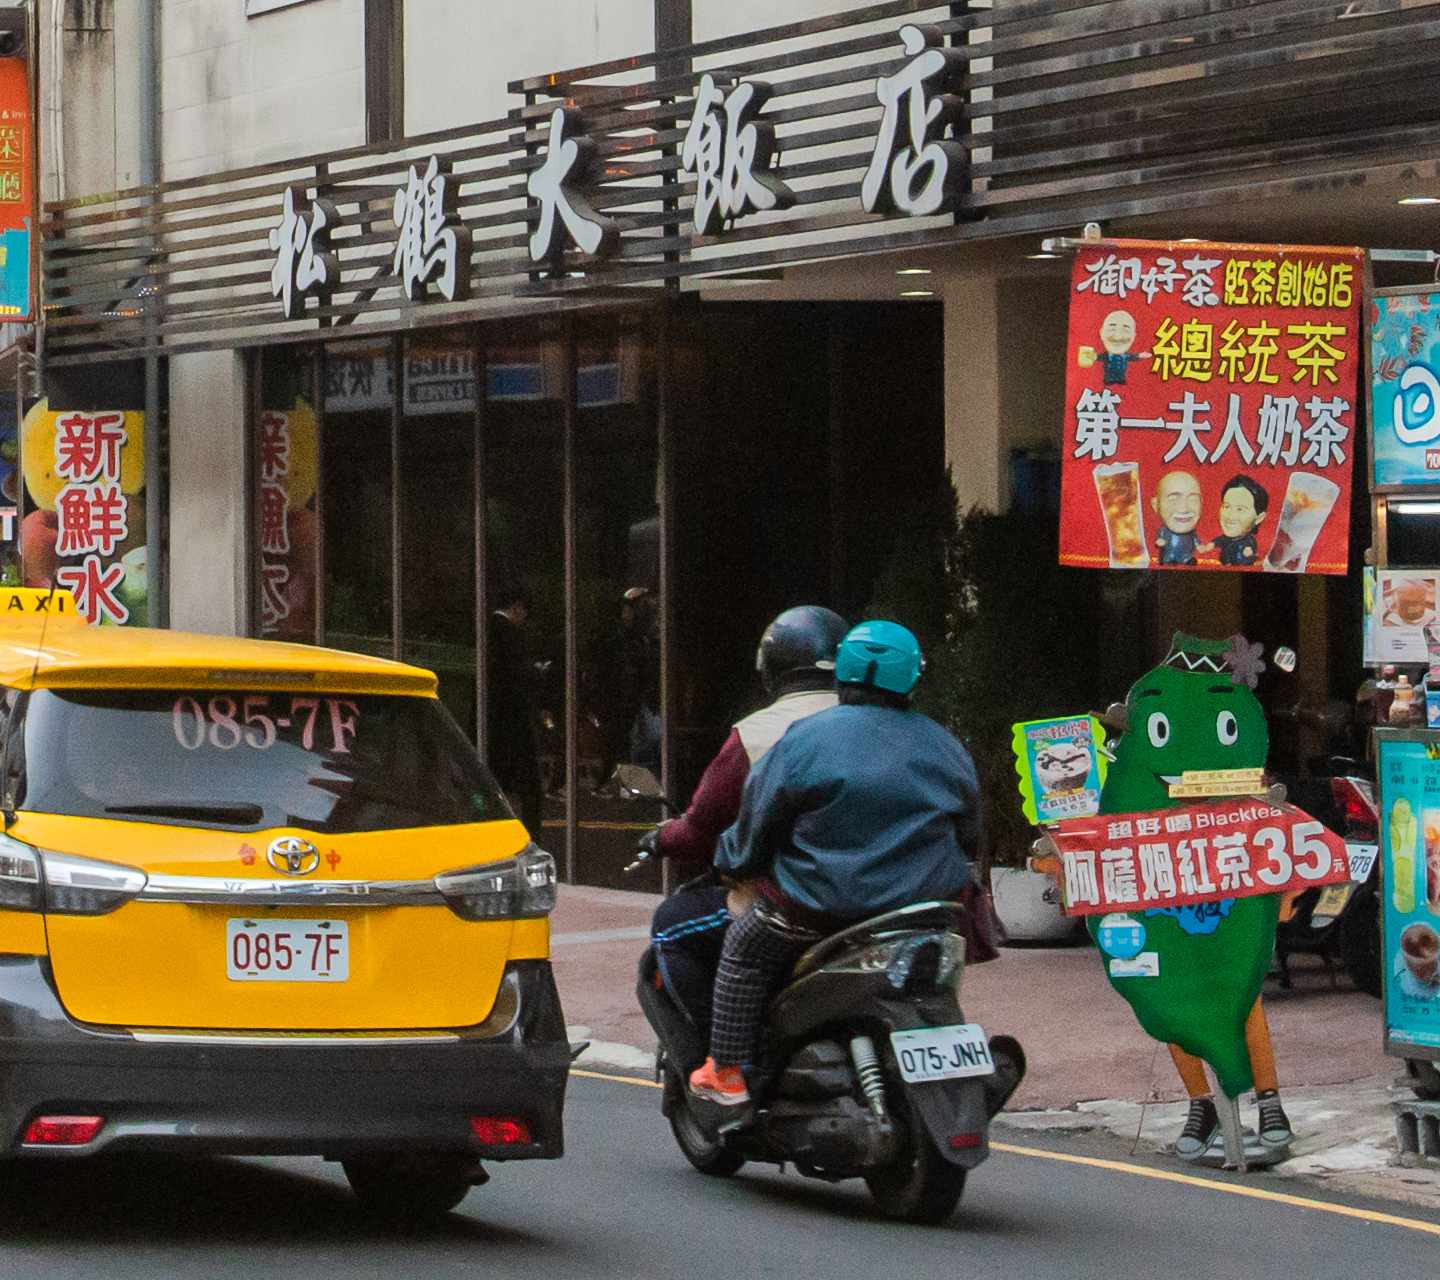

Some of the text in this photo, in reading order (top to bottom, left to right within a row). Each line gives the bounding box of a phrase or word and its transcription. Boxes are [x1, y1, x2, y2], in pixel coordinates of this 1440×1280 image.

[268, 22, 965, 321] 松鶴大飯店
[1077, 254, 1354, 308] 御好茶 紅茶創始店
[1152, 317, 1348, 386] 總統茶
[1074, 388, 1351, 467] 第一夫人奶茶
[171, 694, 361, 756] 085-7F
[1197, 803, 1282, 829] Blacktea
[231, 931, 342, 971] 085-7F
[902, 1042, 991, 1074] 075-JNH
